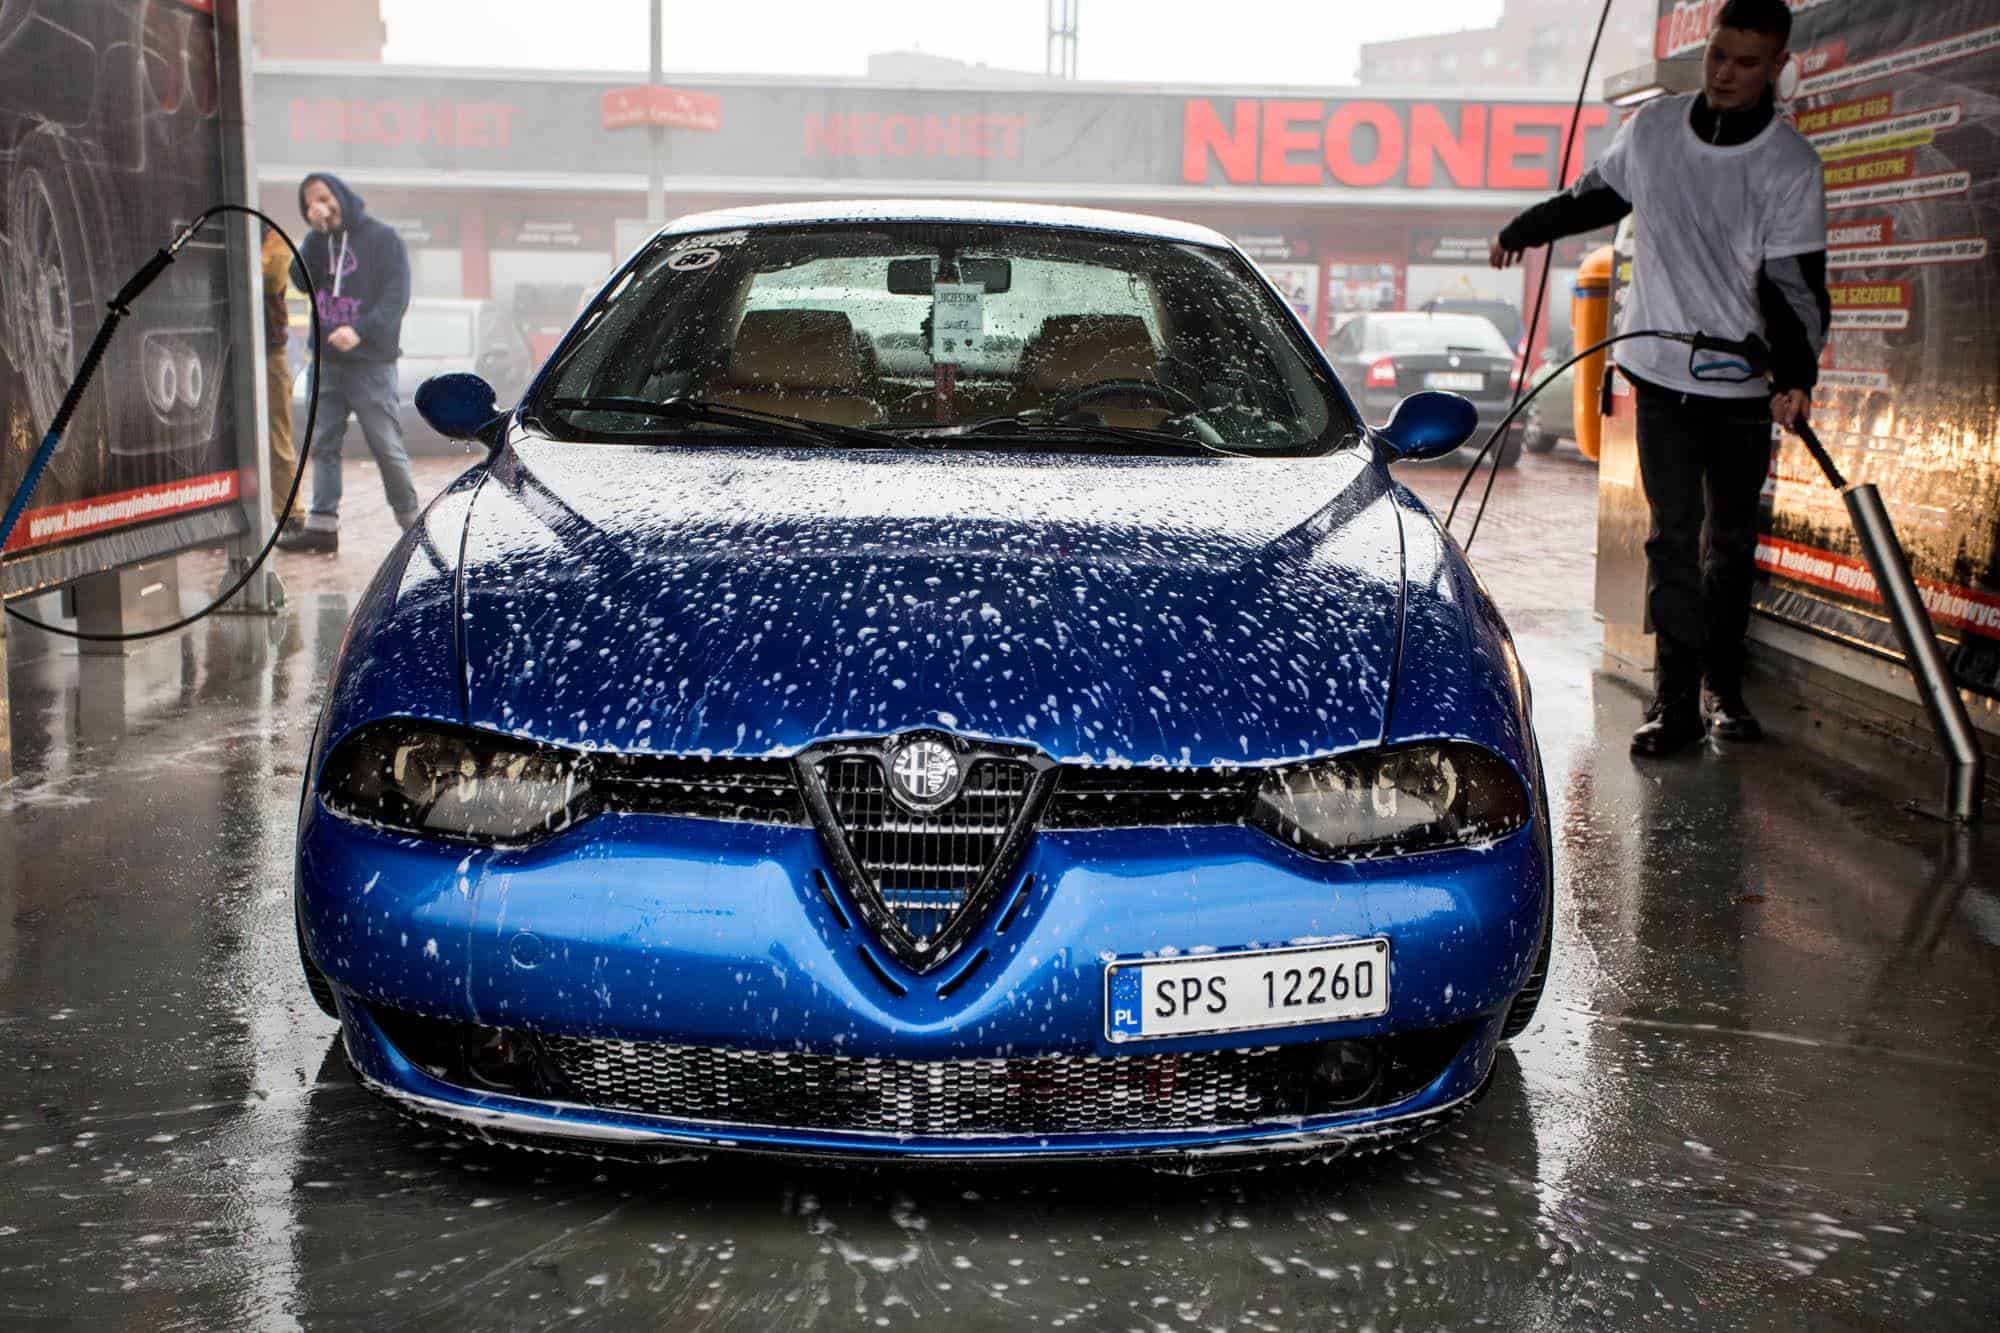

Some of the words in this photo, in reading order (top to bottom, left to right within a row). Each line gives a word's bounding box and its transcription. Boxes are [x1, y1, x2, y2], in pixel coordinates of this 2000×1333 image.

[290, 96, 522, 148] NEONET
[802, 112, 1026, 160] NEONET
[1183, 98, 1608, 189] NEONET
[924, 742, 958, 777] ROMEO
[1155, 975, 1228, 1018] SPS
[1262, 960, 1374, 1009] 12260
[1114, 1009, 1138, 1026] PL
